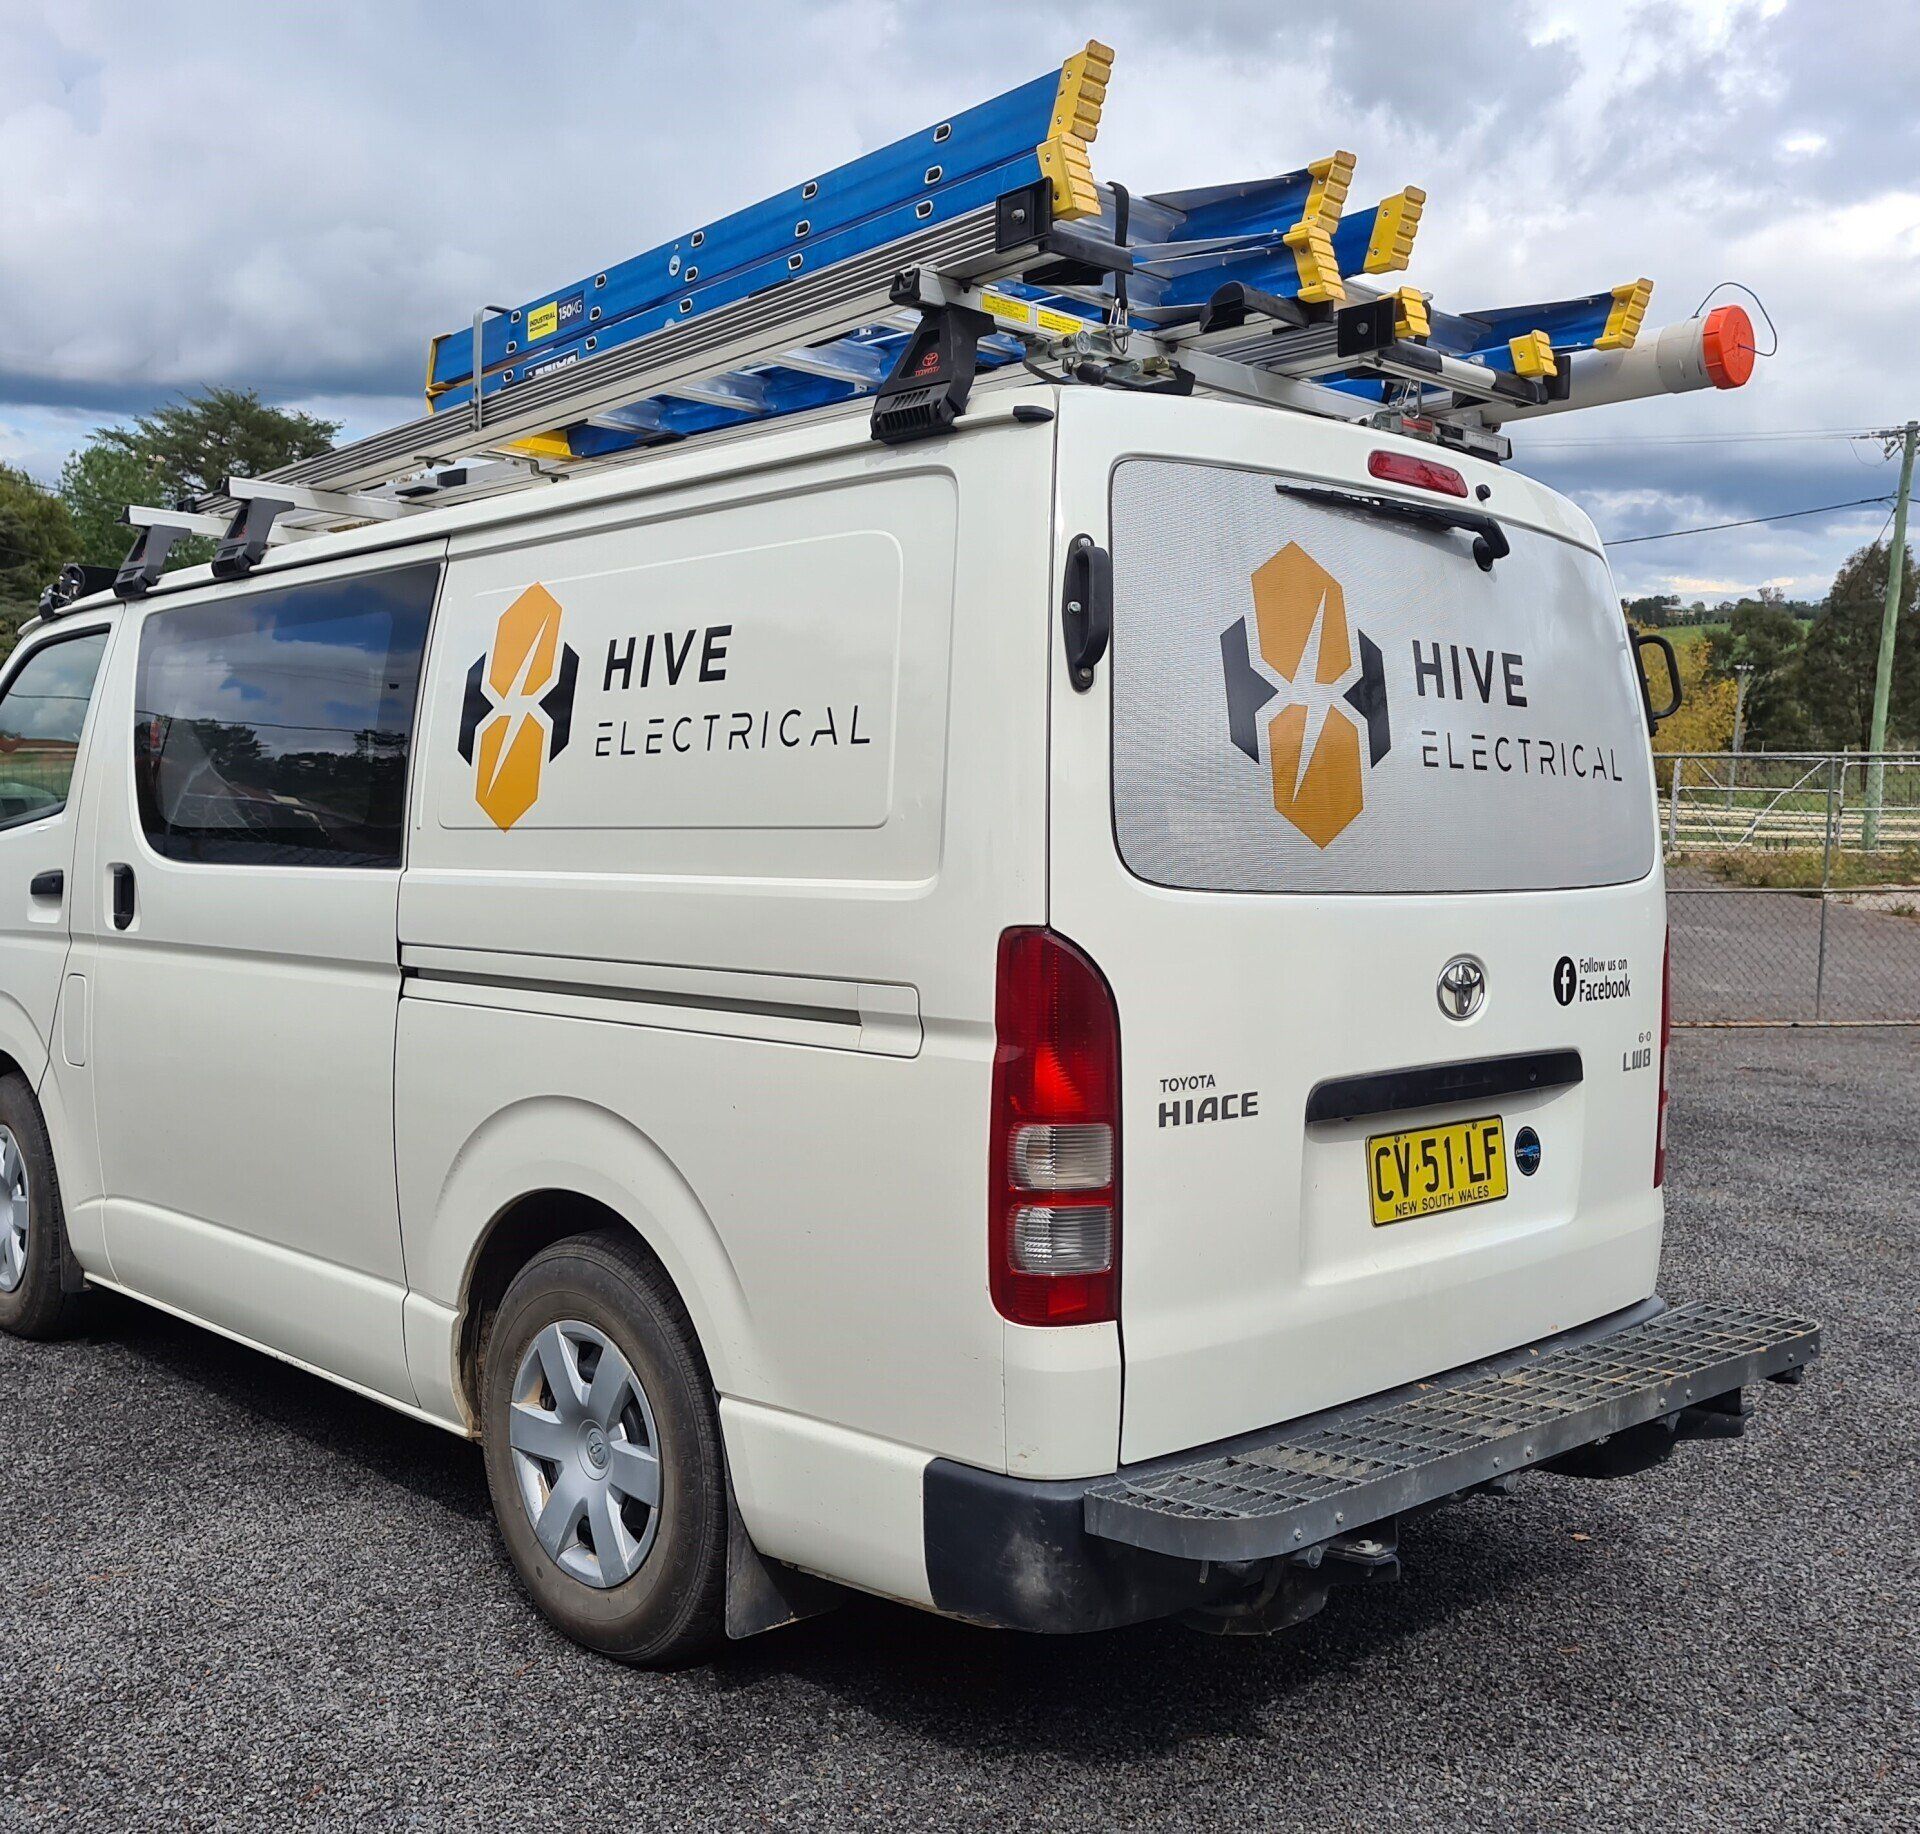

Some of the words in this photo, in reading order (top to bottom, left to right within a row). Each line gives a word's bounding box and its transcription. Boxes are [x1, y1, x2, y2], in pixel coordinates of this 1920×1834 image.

[529, 312, 556, 327] INDUSTRIAL
[603, 624, 733, 691] HIVE
[1412, 639, 1528, 708] HIVE
[595, 705, 870, 757] ELECTRICAL
[1421, 730, 1623, 782] ELECTRICAL
[1579, 957, 1606, 974] Follow
[1607, 960, 1616, 971] us
[1618, 959, 1628, 970] on
[1579, 973, 1631, 1002] Facebook
[1623, 1048, 1651, 1072] LWB
[1160, 1074, 1216, 1093] TOYOTA
[1158, 1091, 1259, 1128] HIACE
[1395, 1201, 1418, 1217] NEW
[1421, 1193, 1455, 1211] SOUTH
[1458, 1185, 1490, 1202] WALES
